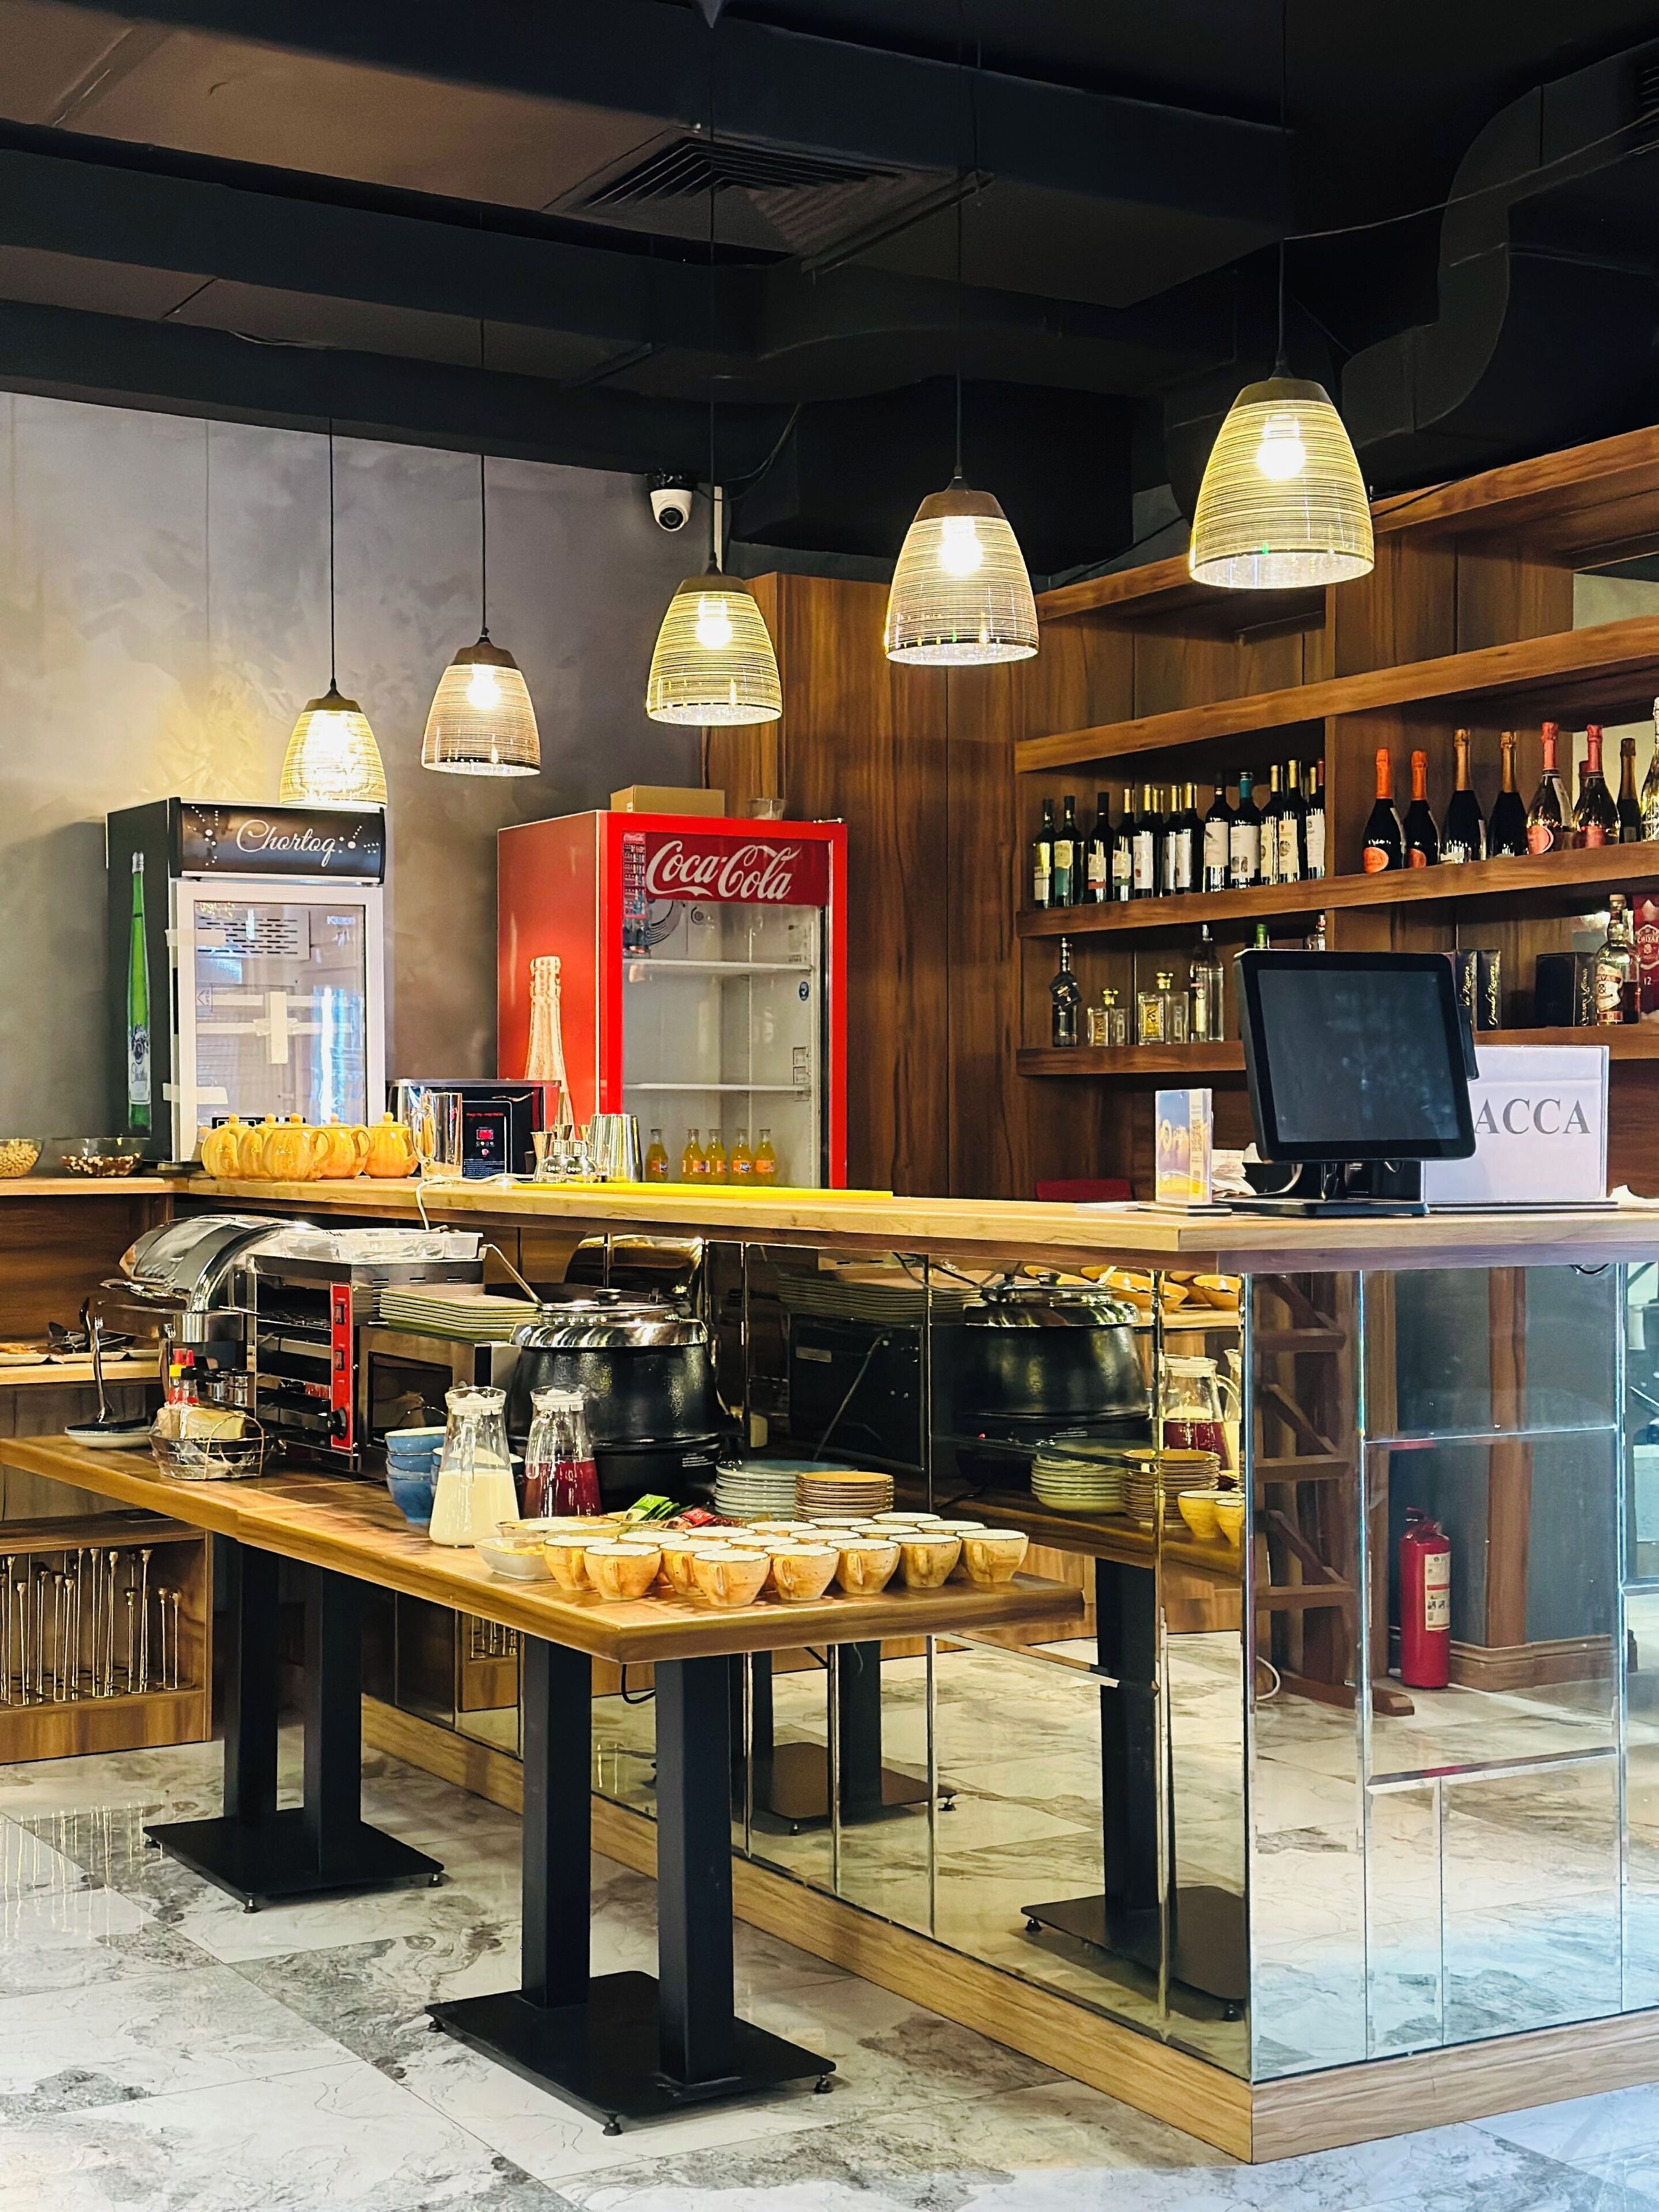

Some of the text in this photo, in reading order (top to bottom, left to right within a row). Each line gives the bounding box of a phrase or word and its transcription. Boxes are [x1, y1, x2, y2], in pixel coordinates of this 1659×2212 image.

[236, 819, 336, 867] Chortoq
[646, 840, 802, 900] Coca-Cola
[1474, 1098, 1591, 1135] АССА
